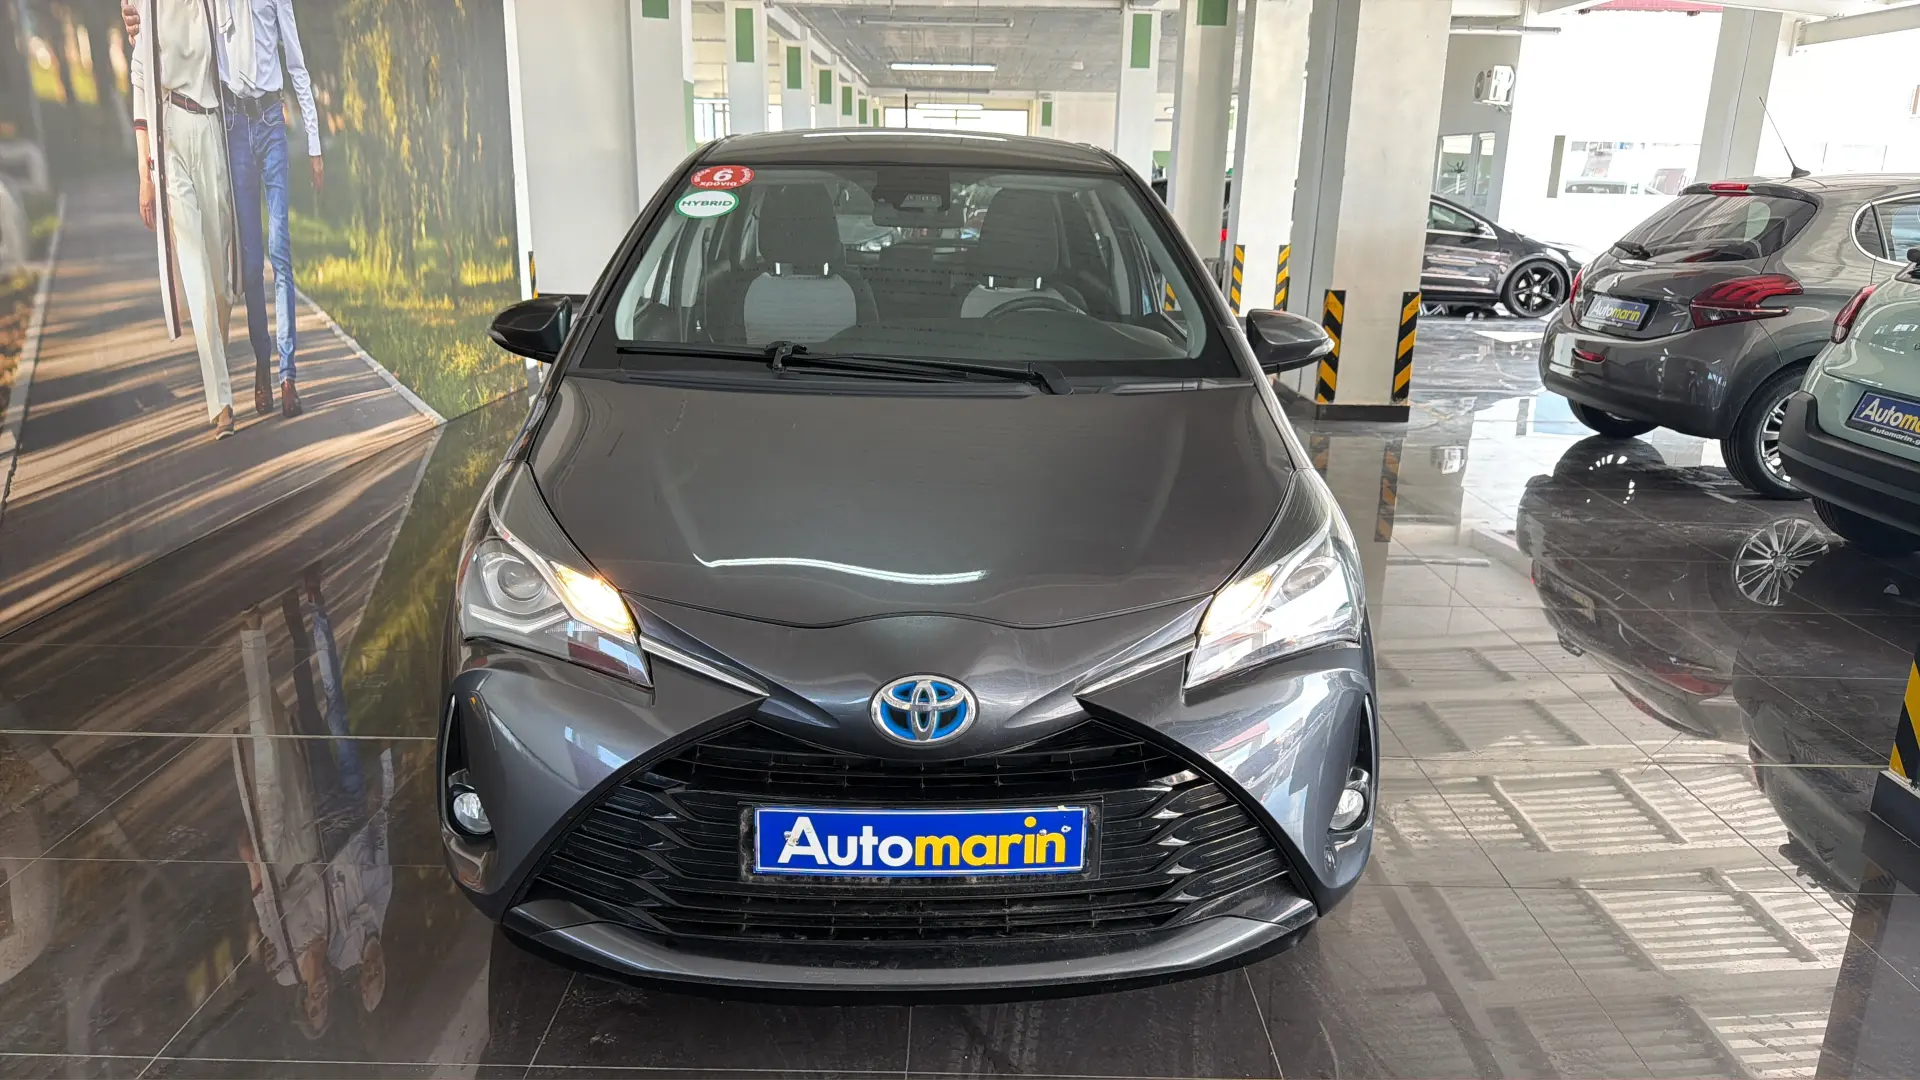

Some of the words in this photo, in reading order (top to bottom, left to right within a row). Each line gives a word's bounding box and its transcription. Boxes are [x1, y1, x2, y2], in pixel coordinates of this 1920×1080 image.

[713, 170, 734, 182] 6
[1590, 300, 1641, 321] Automarin
[777, 816, 1066, 867] Automarin
